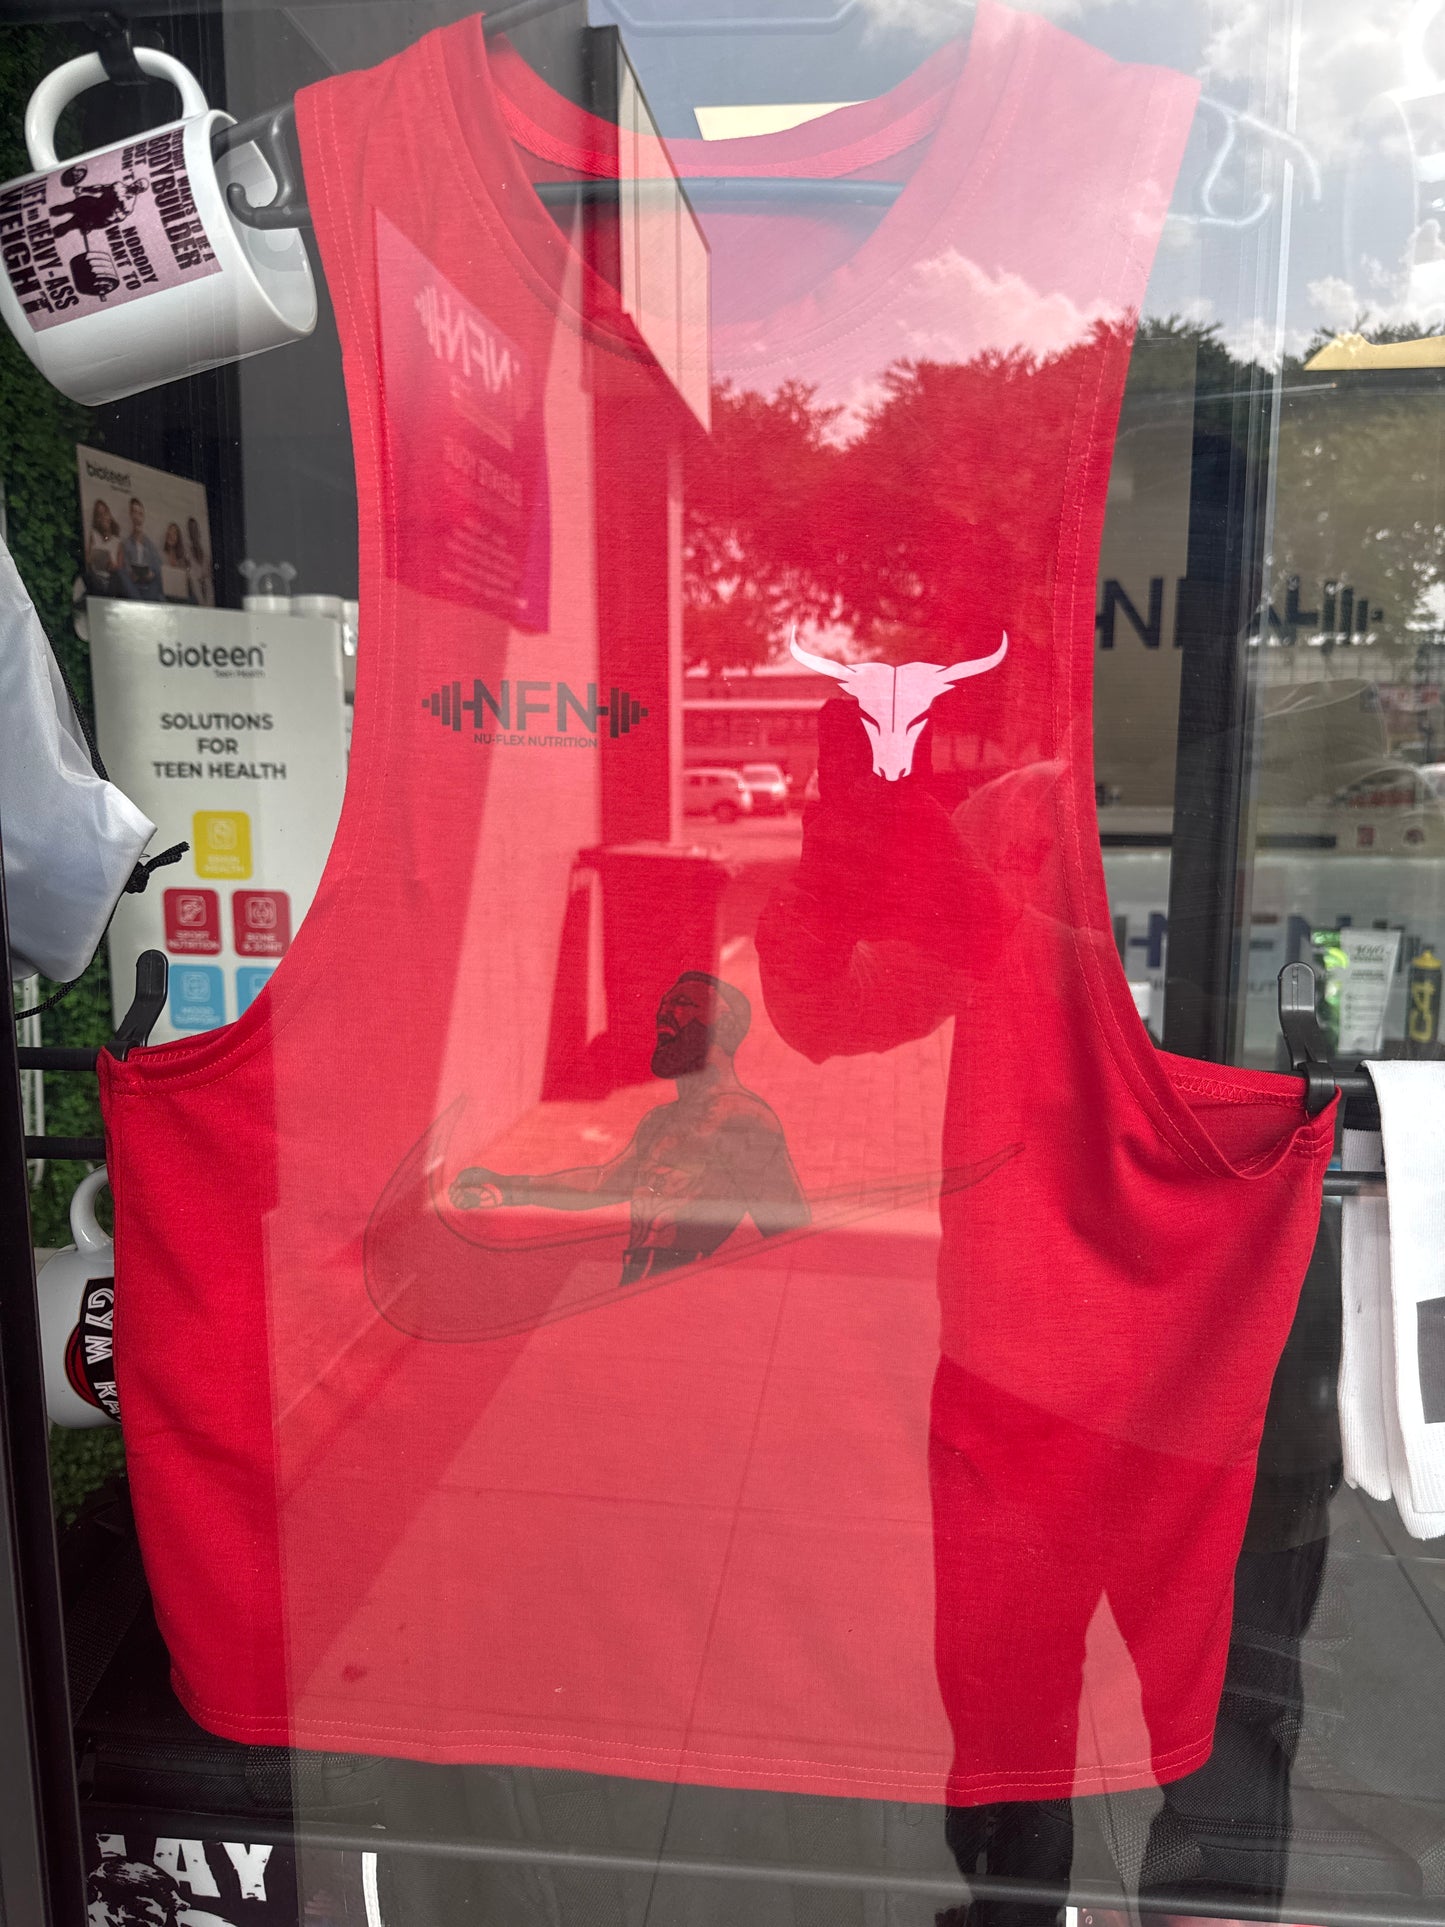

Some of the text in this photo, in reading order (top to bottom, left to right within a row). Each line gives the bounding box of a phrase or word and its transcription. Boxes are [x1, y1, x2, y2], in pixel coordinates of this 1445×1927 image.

[122, 147, 135, 181] DON'T
[134, 142, 147, 165] BUT
[22, 177, 47, 209] LIFT
[148, 133, 202, 270] BODYBUILDER
[177, 175, 198, 216] WANTS
[188, 217, 204, 233] TO
[202, 251, 216, 262] A
[0, 186, 55, 314] WEIGHT
[26, 219, 80, 311] HEAVY-ASS
[105, 225, 142, 291] WANT TO
[122, 226, 159, 284] NOBODY
[158, 642, 265, 668] bioteen
[161, 712, 273, 730] SOLUTIONS
[474, 679, 598, 733] NFN
[197, 737, 238, 755] FOR
[474, 734, 598, 748] NU-FLEX NUTRITION
[153, 761, 287, 780] TEEN HEALTH
[85, 1287, 114, 1365] GYM
